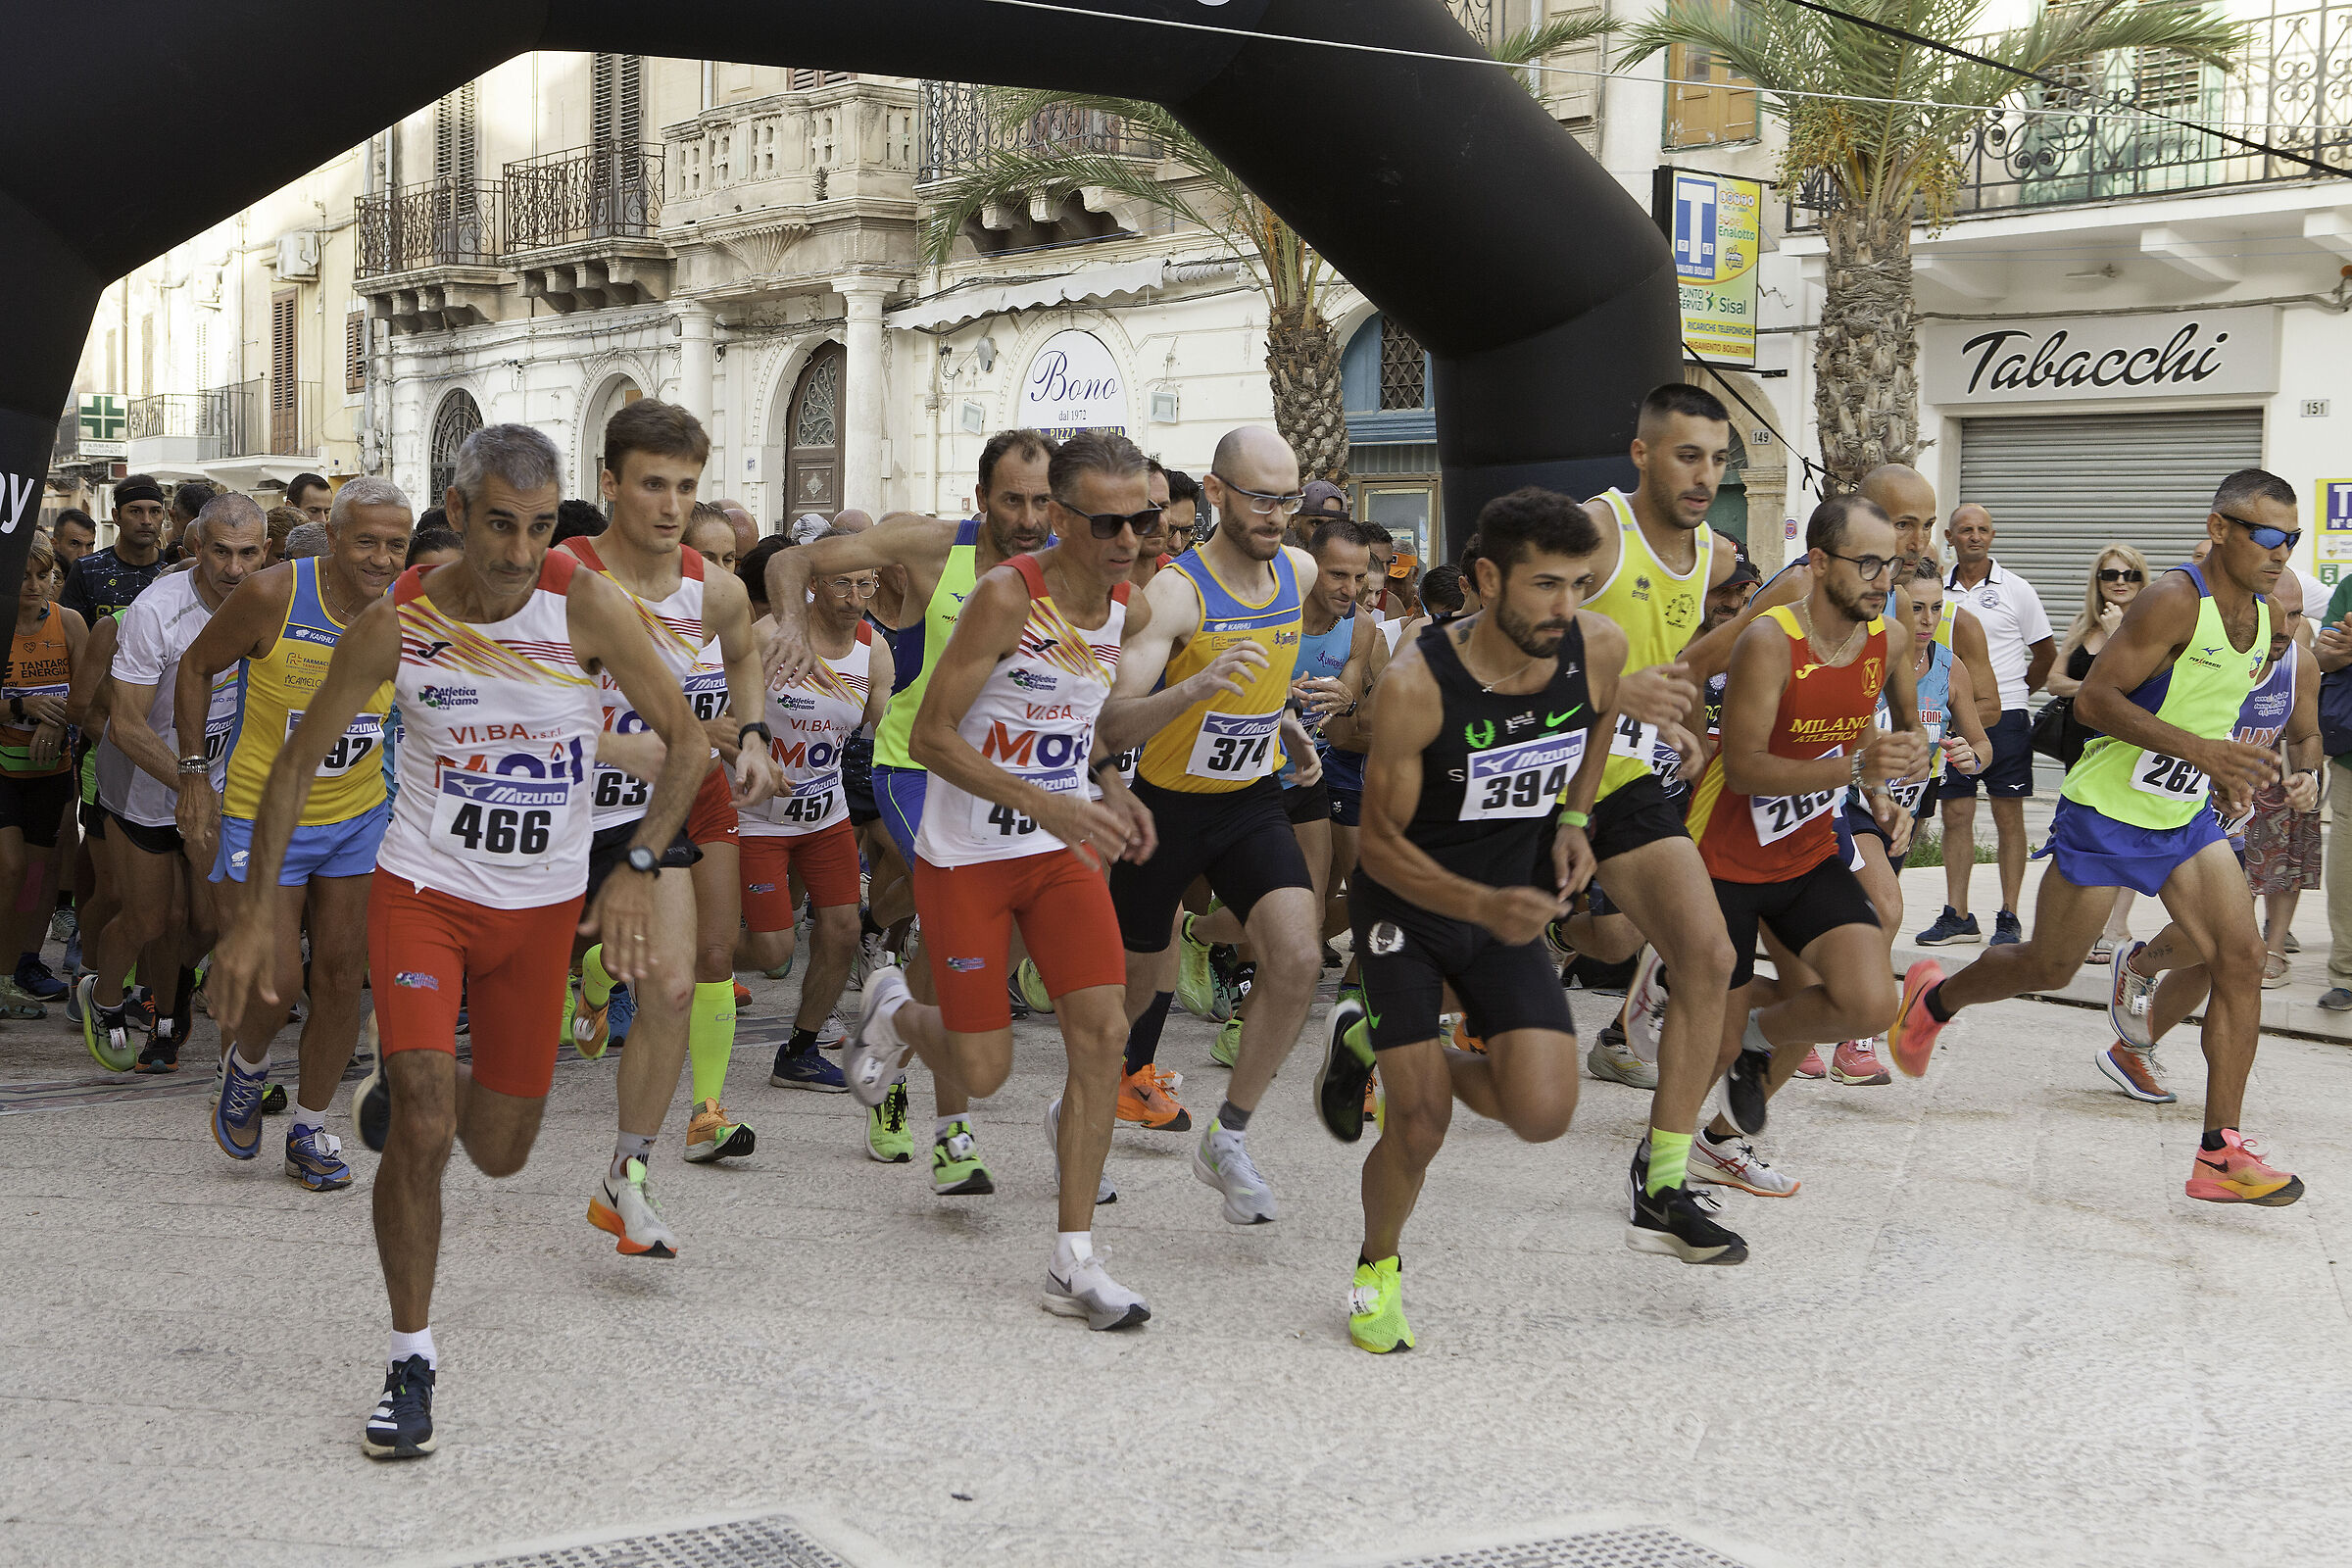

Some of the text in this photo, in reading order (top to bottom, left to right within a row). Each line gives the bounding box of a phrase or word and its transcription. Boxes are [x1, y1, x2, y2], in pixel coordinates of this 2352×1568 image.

[1718, 226, 1755, 241] Enalotto
[1678, 287, 1703, 299] PUNTO
[1719, 297, 1746, 315] Sisal
[1687, 321, 1752, 336] RICARICHE TELEFONICHE
[1687, 340, 1752, 355] PAGAMENTO BOLLETTINI
[1961, 321, 2230, 395] Tabacchi
[1030, 350, 1119, 402] Bono
[1058, 409, 1087, 421] dal 1972
[2306, 401, 2326, 416] 151
[1050, 427, 1077, 440] PIZZA
[1752, 431, 1770, 443] 149
[0, 471, 35, 535] y
[310, 632, 335, 644] KARHU
[304, 658, 329, 666] FARMACI
[22, 666, 68, 678] ENERGIA
[440, 686, 477, 699] Atletica
[441, 694, 479, 706] Alcamo
[683, 691, 729, 721] 67
[1614, 715, 1642, 749] 4
[1792, 731, 1858, 743] ATLETICA
[323, 737, 374, 769] 92
[1207, 736, 1271, 772] 374
[591, 772, 649, 808] 63
[1482, 763, 1568, 810] 394
[783, 790, 834, 822] 457
[450, 803, 552, 855] 466
